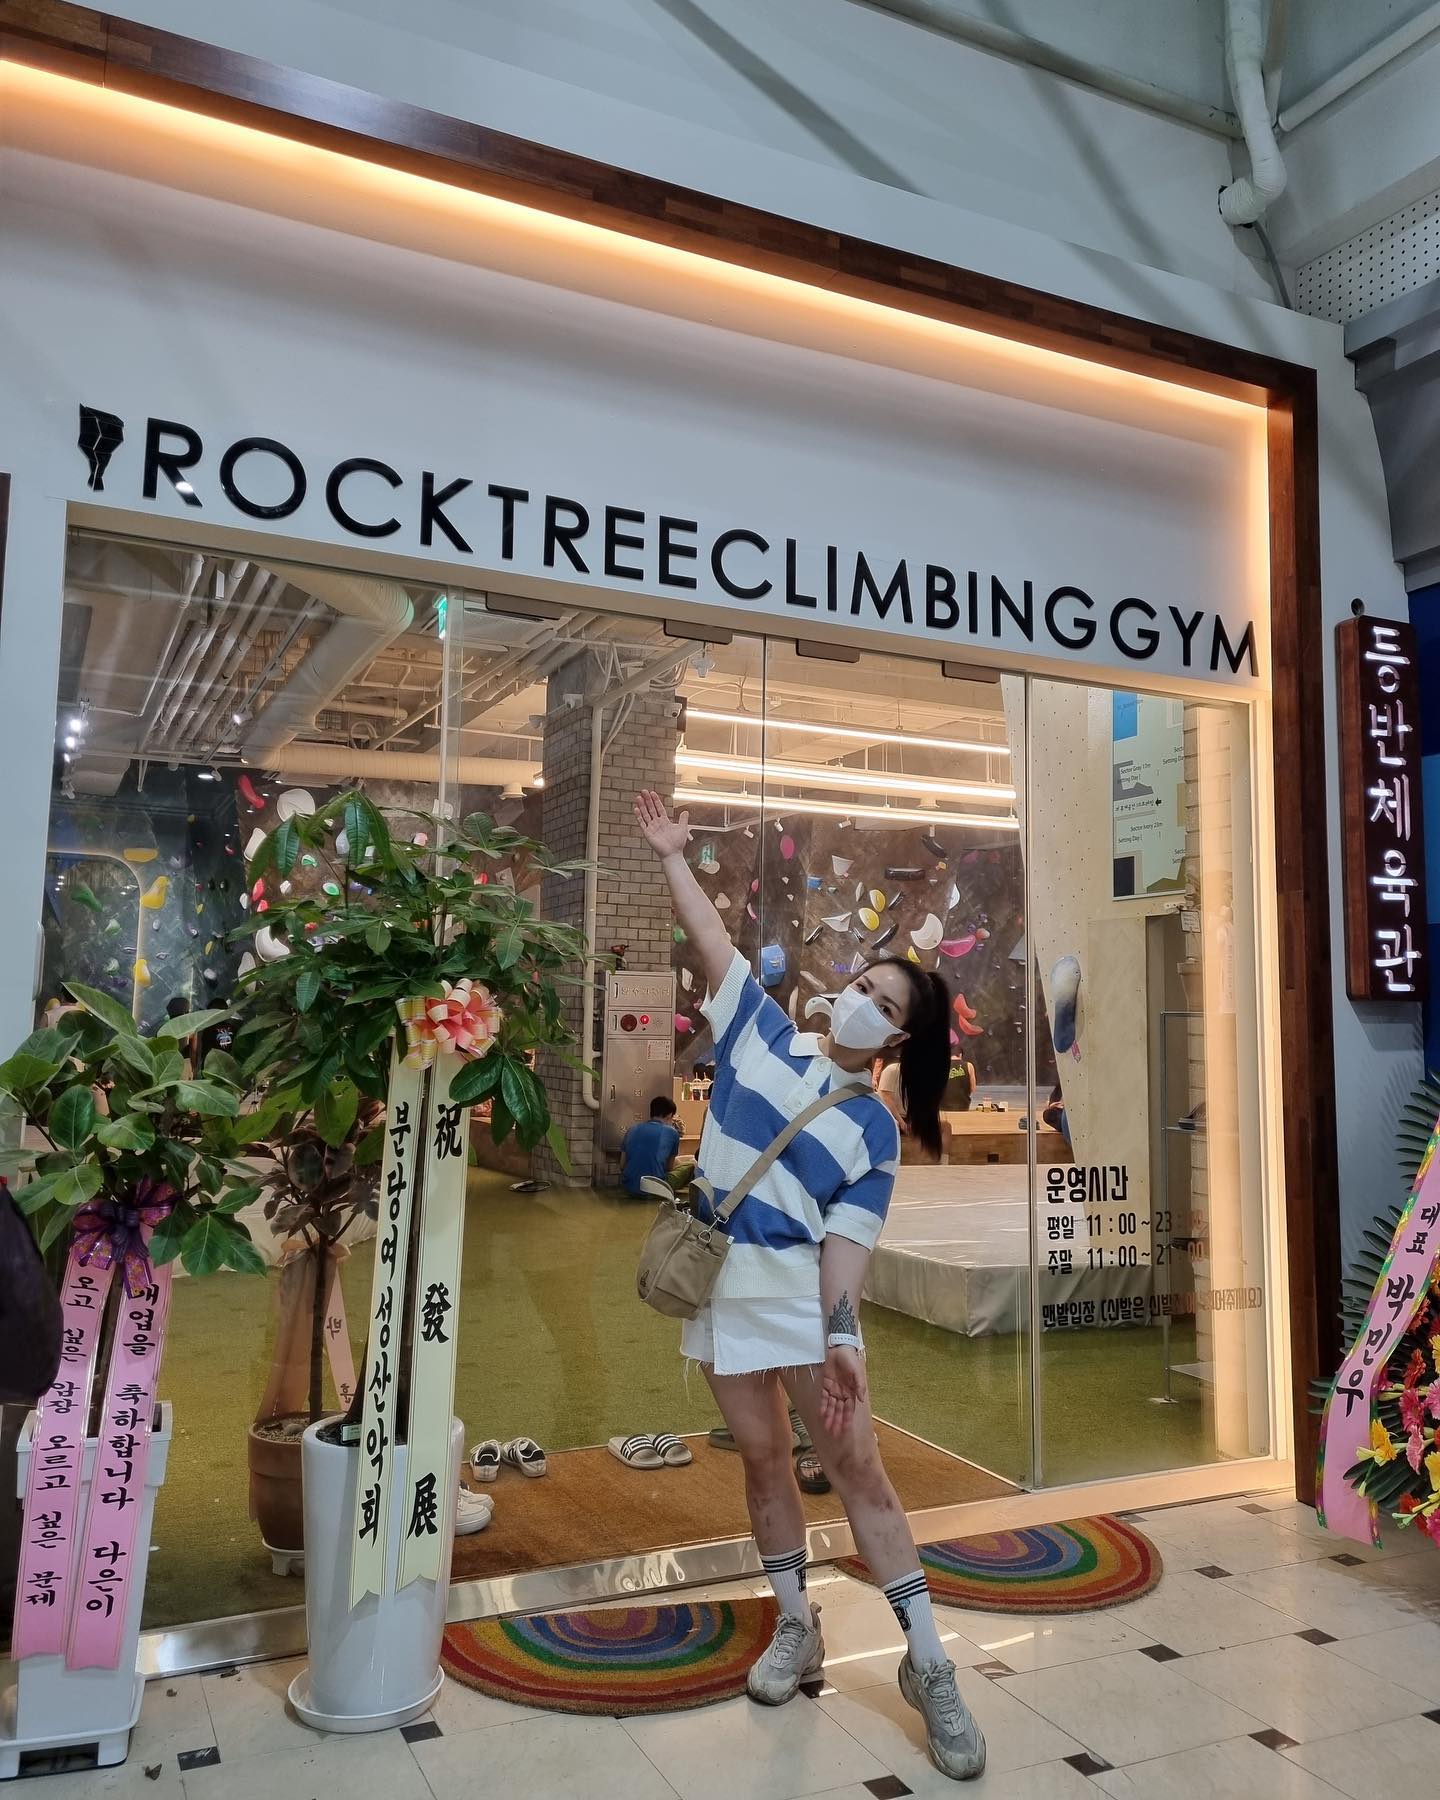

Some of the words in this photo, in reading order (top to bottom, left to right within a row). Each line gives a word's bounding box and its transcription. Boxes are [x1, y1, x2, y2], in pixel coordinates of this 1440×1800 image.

[1366, 625, 1422, 992] 등반체육관
[1046, 1165, 1129, 1203] 운영시간
[1047, 1216, 1075, 1240] 평일
[1404, 1202, 1440, 1255] 대표
[1048, 1249, 1073, 1276] 주말
[66, 1276, 99, 1309] 오고
[359, 1101, 411, 1547] 분당여성산악회
[1042, 1300, 1096, 1328] 맨발입장
[61, 1328, 87, 1362] 싶은
[1335, 1274, 1416, 1418] 박민우
[45, 1381, 80, 1414] 암장
[36, 1435, 75, 1490] 오르고
[100, 1384, 149, 1510] 축하합니다
[31, 1511, 66, 1549] 싶은
[24, 1570, 62, 1607] 문제
[86, 1541, 127, 1618] 다은이
